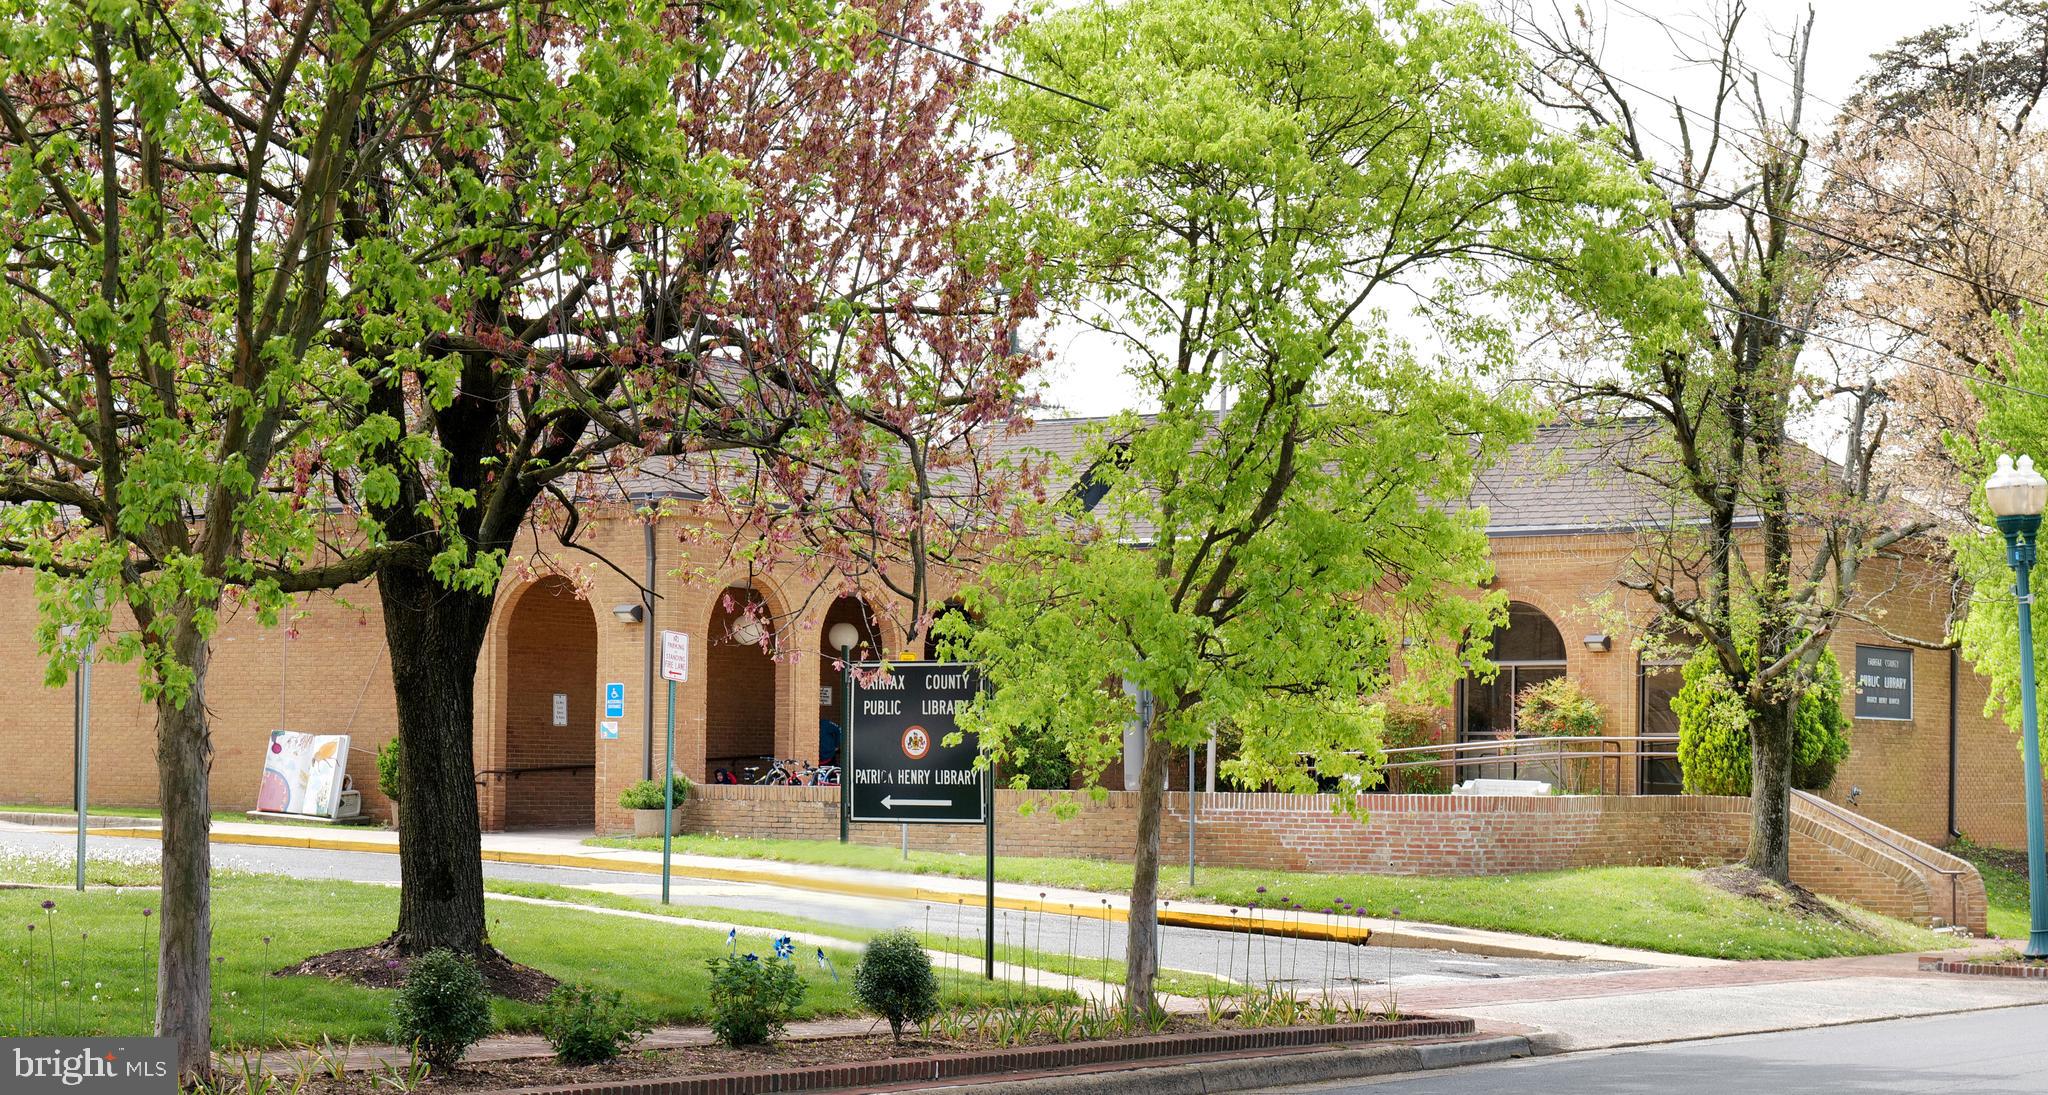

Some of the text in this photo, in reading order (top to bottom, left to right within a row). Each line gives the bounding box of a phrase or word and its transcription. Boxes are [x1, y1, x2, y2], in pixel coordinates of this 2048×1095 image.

[665, 653, 686, 662] STANDING
[675, 662, 686, 671] LANE
[863, 674, 970, 690] AIRAX COUNTY
[1860, 674, 1906, 689] PUBLIC LIBRARY
[863, 700, 902, 715] PUBLIC
[897, 769, 931, 785] HENRY
[935, 769, 977, 785] LIBRARY
